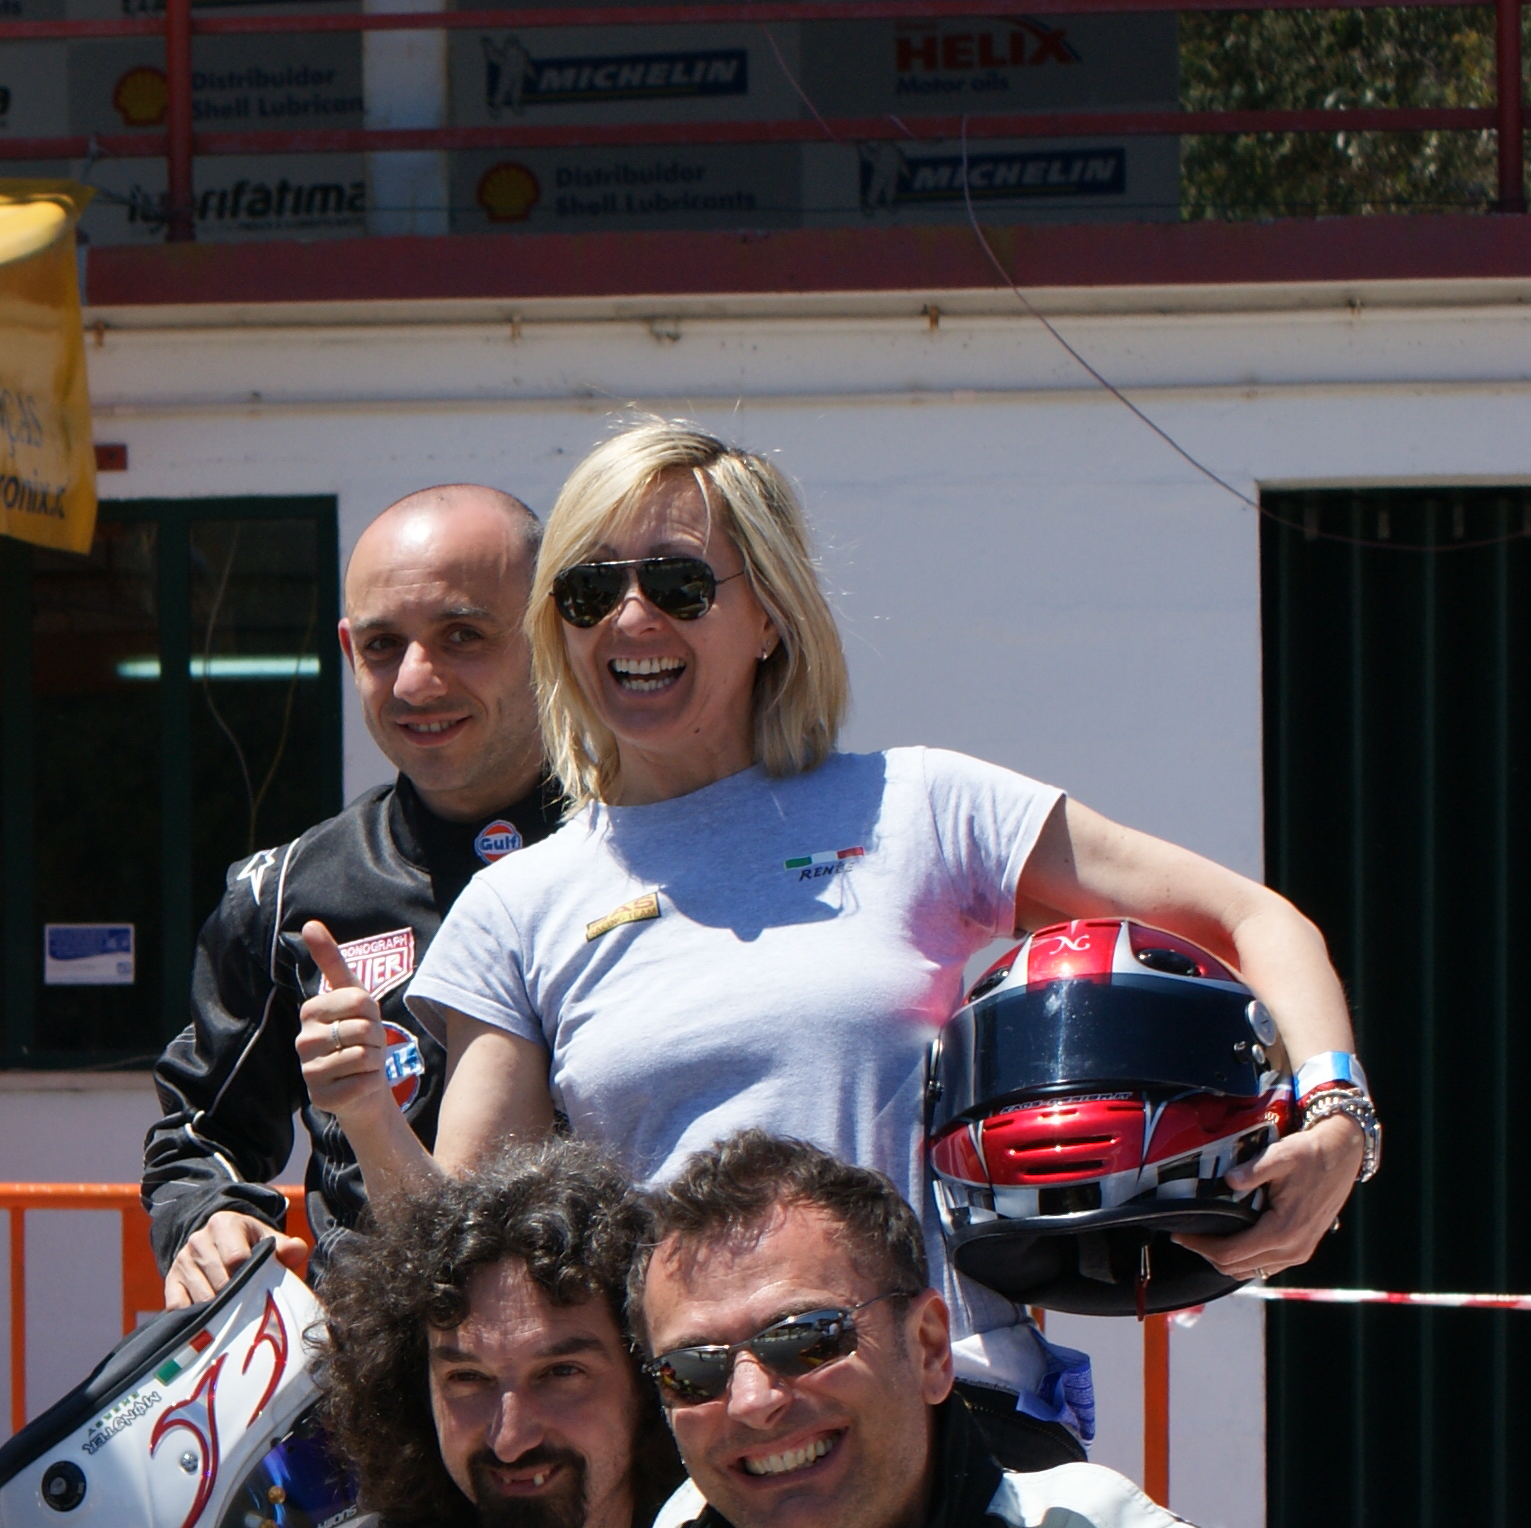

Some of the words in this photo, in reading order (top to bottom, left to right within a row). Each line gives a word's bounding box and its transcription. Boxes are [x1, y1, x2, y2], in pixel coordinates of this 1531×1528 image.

[894, 28, 1076, 72] HELIX
[192, 65, 336, 92] Distribuidor
[540, 59, 737, 91] MICHELIN
[894, 76, 963, 95] Motor
[971, 72, 1009, 93] oils
[555, 162, 707, 188] Distribuidor
[913, 158, 1116, 191] MICHELIN
[555, 194, 618, 217] Shell
[480, 834, 518, 852] Gulf
